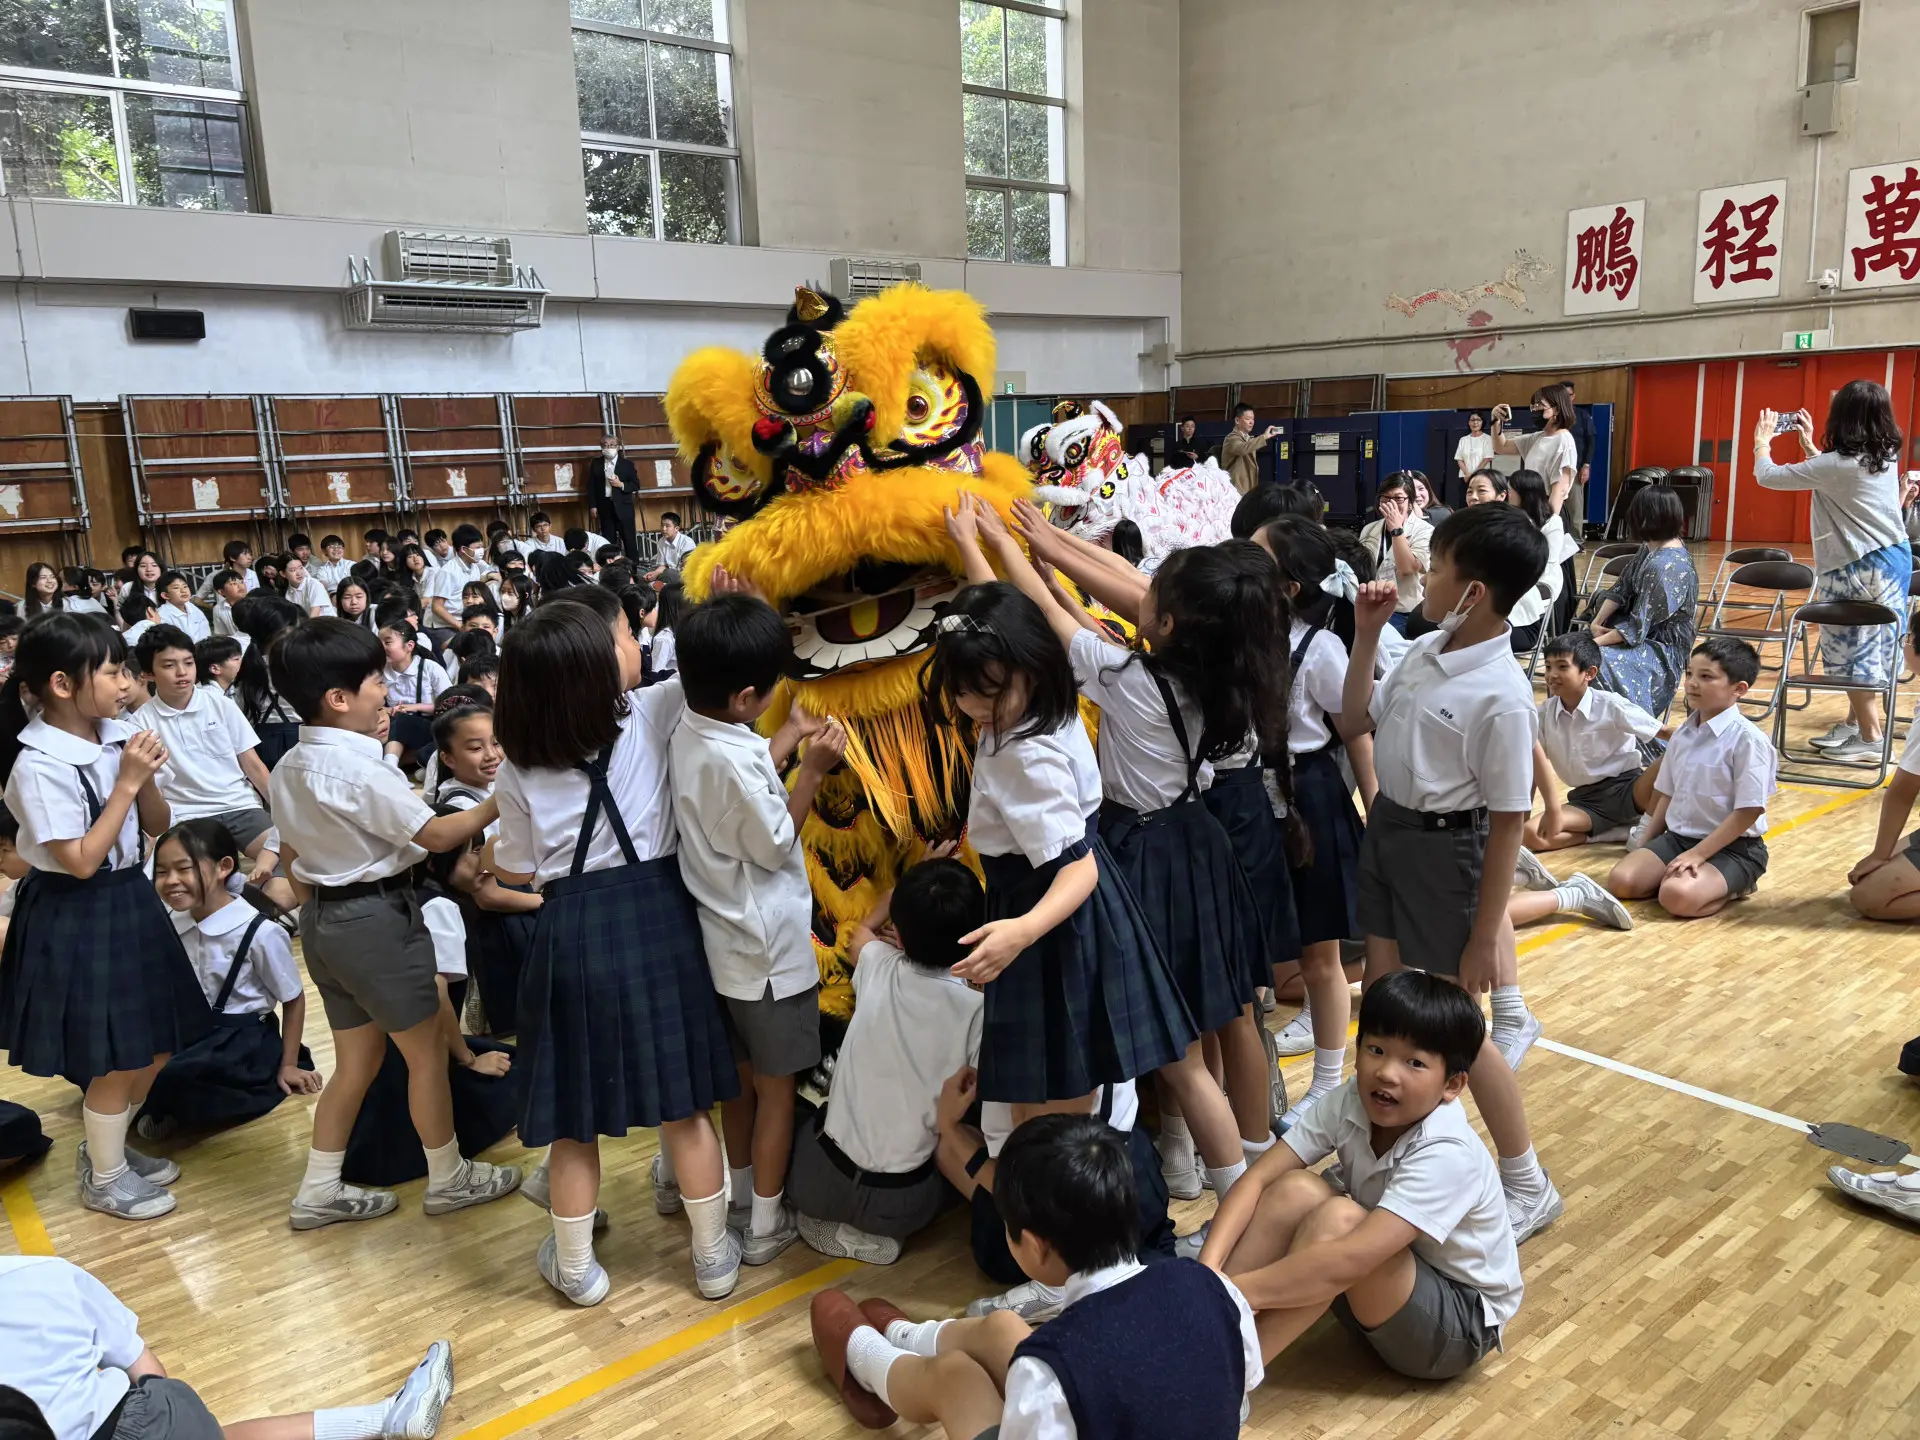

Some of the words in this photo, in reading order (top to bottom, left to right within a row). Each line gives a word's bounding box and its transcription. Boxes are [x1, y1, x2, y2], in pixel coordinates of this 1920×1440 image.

[1572, 207, 1638, 301] 鵬
[1701, 194, 1780, 289] 程
[315, 402, 341, 427] 12
